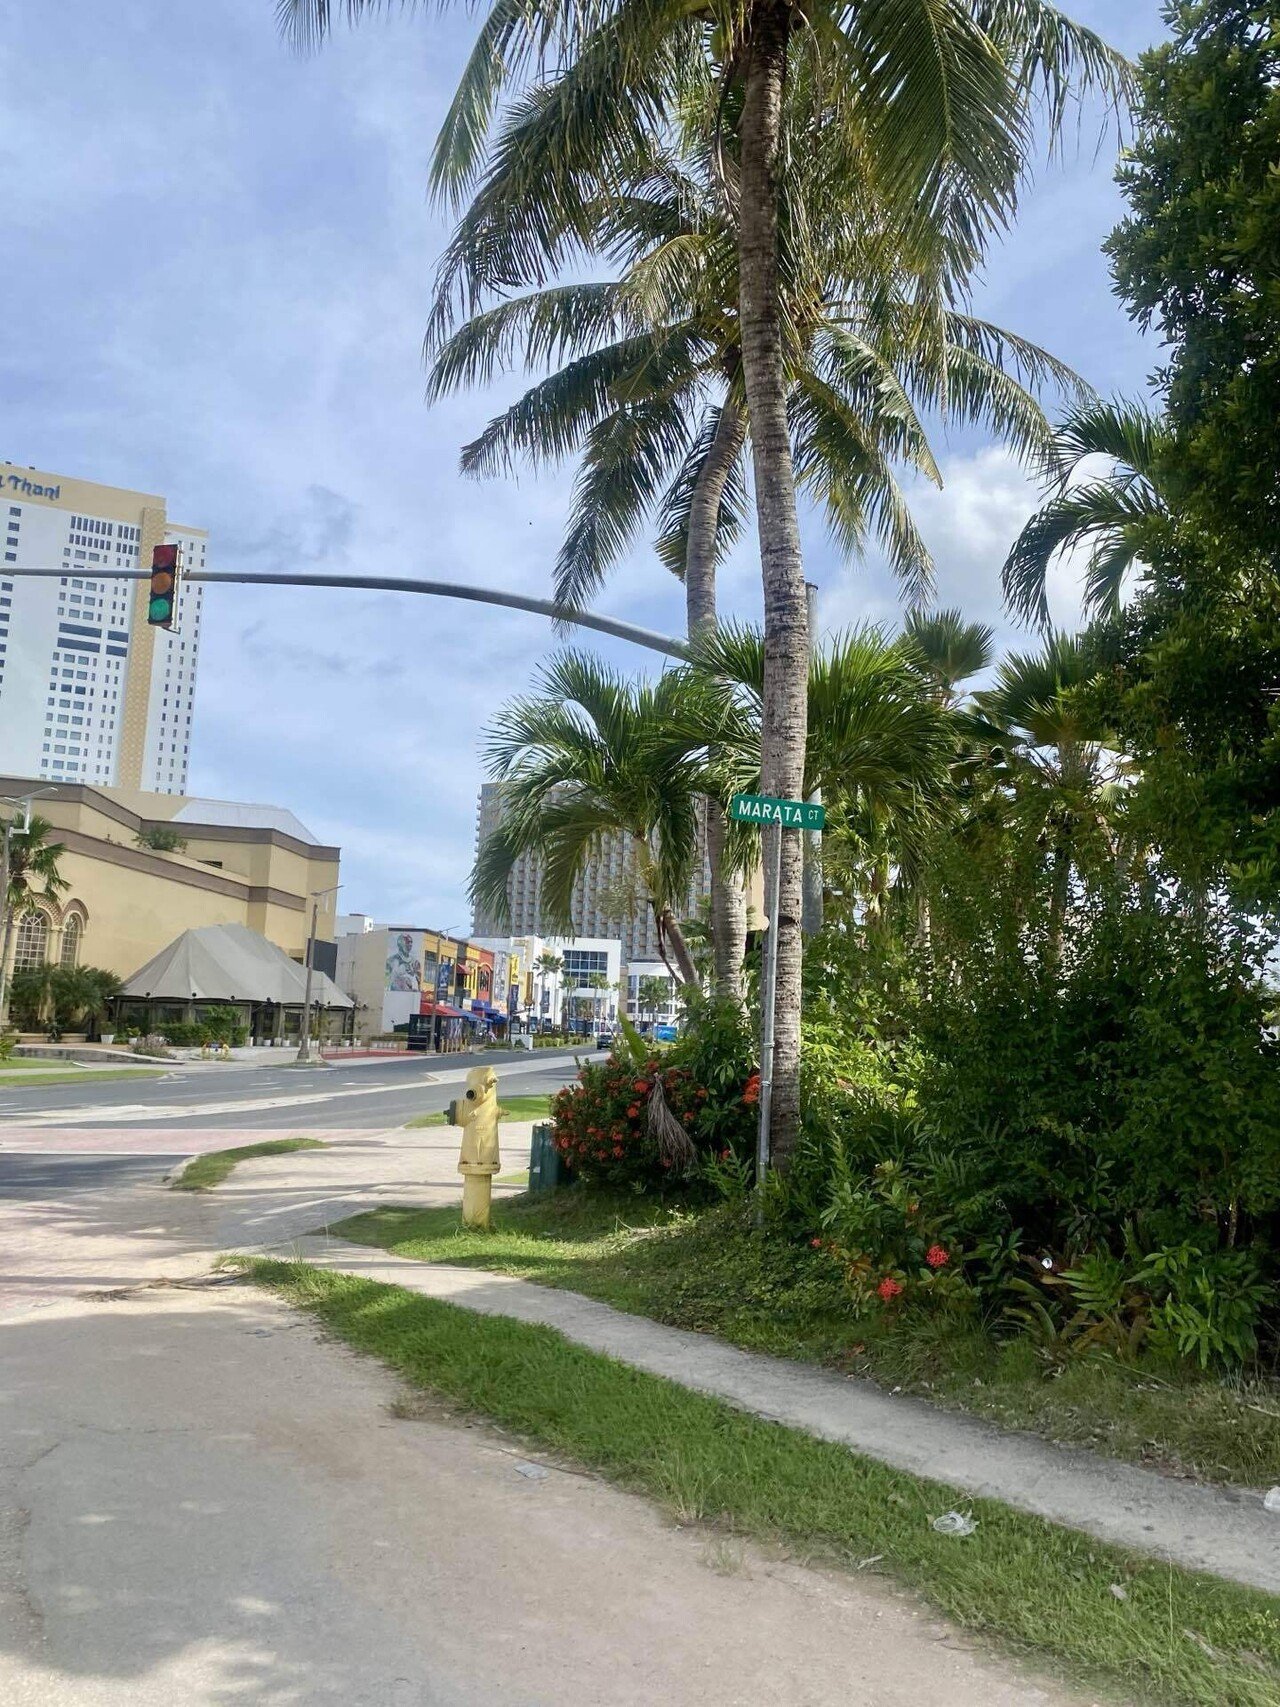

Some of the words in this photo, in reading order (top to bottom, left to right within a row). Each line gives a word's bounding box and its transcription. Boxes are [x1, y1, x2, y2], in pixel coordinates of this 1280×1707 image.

[8, 475, 60, 500] Thani
[738, 800, 803, 823] MARATA
[808, 809, 819, 821] CT
